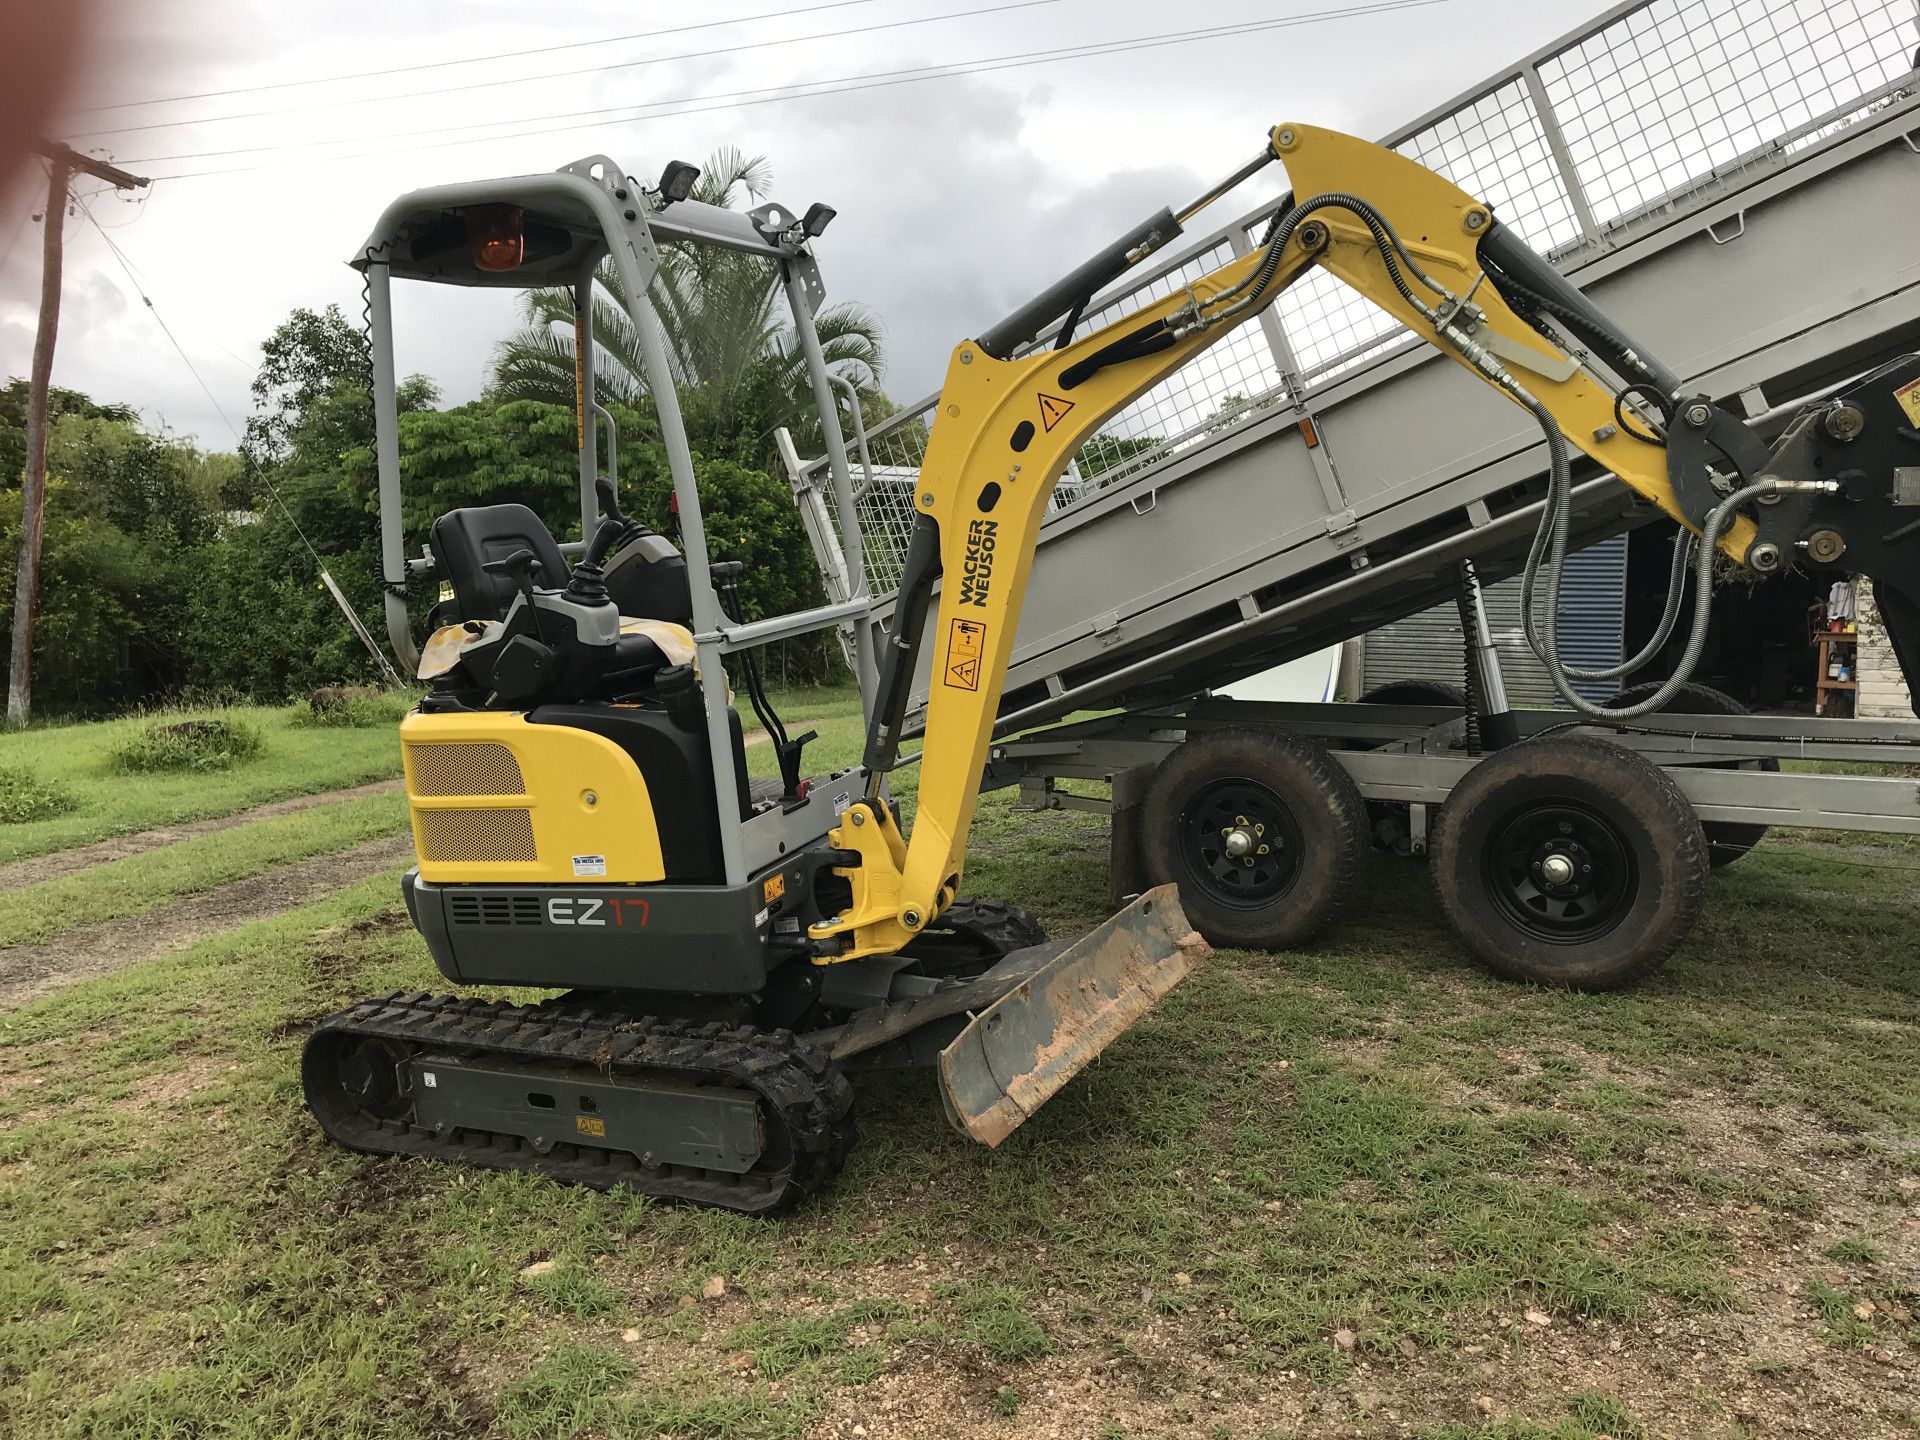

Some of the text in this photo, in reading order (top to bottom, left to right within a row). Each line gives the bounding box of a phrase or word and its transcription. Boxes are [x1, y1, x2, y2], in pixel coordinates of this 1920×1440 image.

[959, 519, 984, 605] WACKER
[973, 520, 998, 608] NEUSON
[547, 898, 650, 926] EZ17
